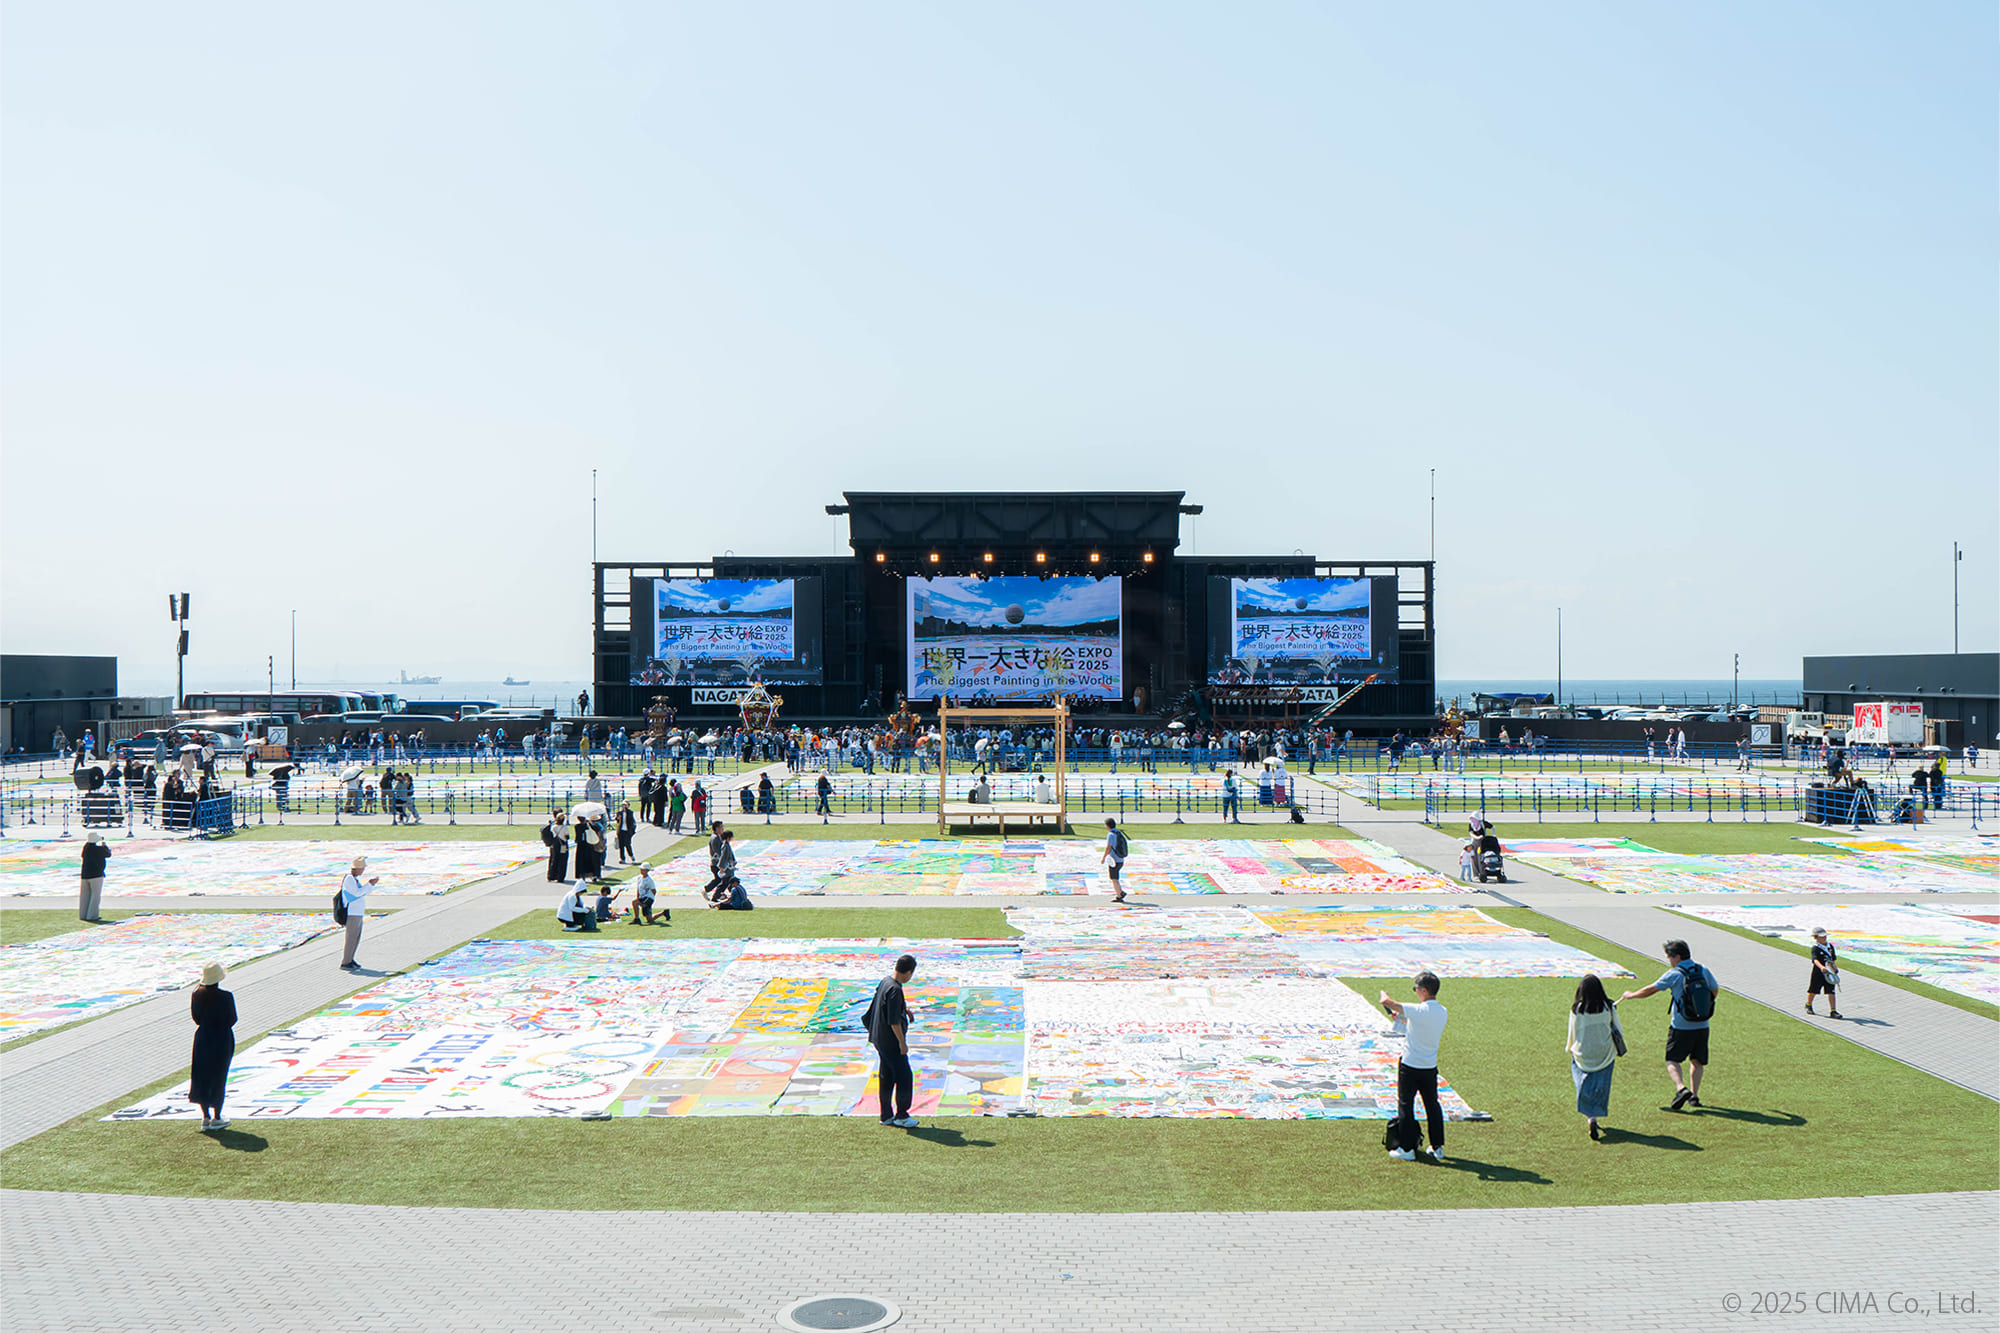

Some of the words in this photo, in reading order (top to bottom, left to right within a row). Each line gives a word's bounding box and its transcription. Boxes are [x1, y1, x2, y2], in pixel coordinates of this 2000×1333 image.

[664, 625, 763, 640] 世界一大きな絵
[1242, 624, 1340, 640] 世界一大きな絵
[922, 647, 1076, 670] 世界一大きな絵
[1078, 648, 1113, 658] EXPO
[1078, 660, 1109, 670] 2025
[924, 676, 942, 685] The
[948, 676, 989, 687] Biggest
[993, 676, 1040, 687] Painting
[1044, 676, 1053, 685] in
[1078, 676, 1112, 685] World
[694, 690, 749, 702] NAGAT
[410, 1034, 494, 1064] ECOLE
[480, 1044, 531, 1069] PARIS
[252, 1041, 402, 1105] BEAUCOURT
[329, 1077, 439, 1115] BOLLE
[441, 1075, 494, 1098] 2024
